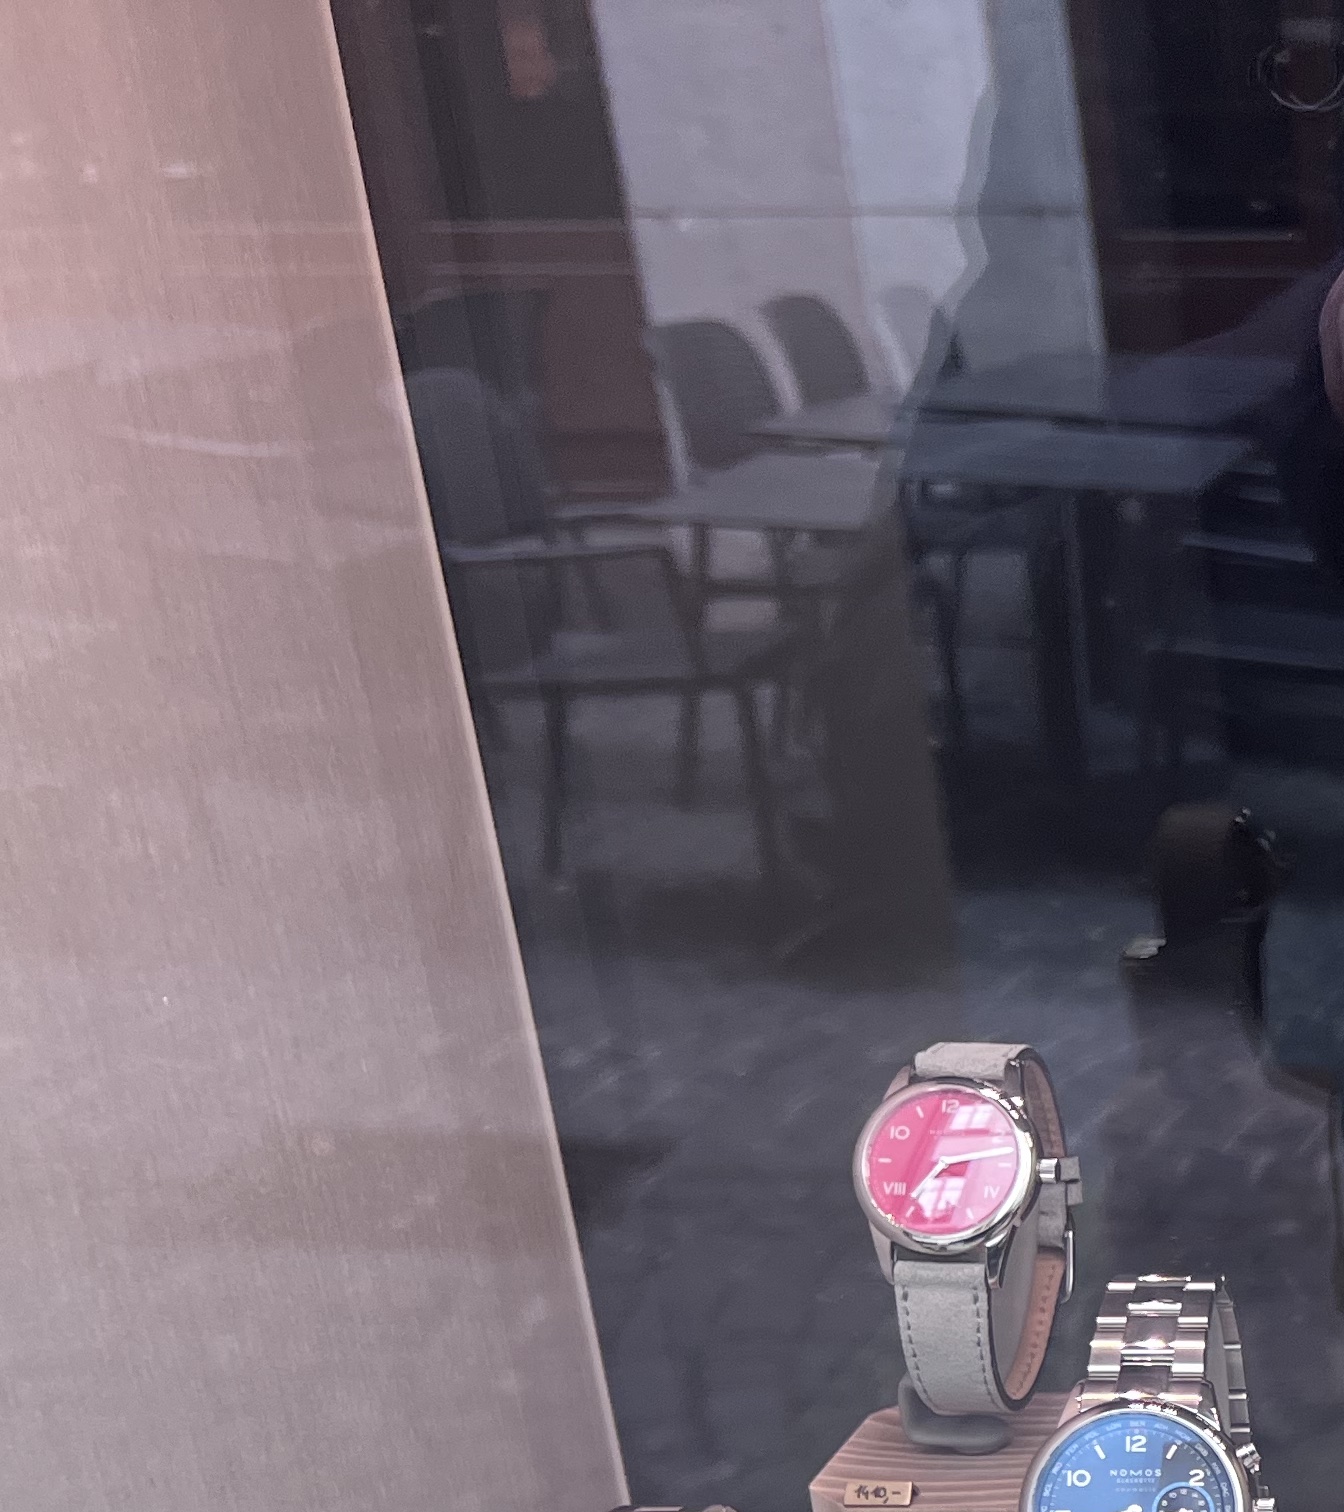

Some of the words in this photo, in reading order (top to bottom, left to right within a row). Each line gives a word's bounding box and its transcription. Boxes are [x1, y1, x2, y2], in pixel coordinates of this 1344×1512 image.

[942, 1099, 960, 1114] 12
[889, 1126, 911, 1140] 10
[883, 1181, 906, 1196] VIII
[983, 1186, 1000, 1199] IV
[1126, 1434, 1147, 1453] 12
[1066, 1469, 1092, 1487] 10
[1109, 1469, 1162, 1477] NOMOS
[1188, 1469, 1205, 1487] 2
